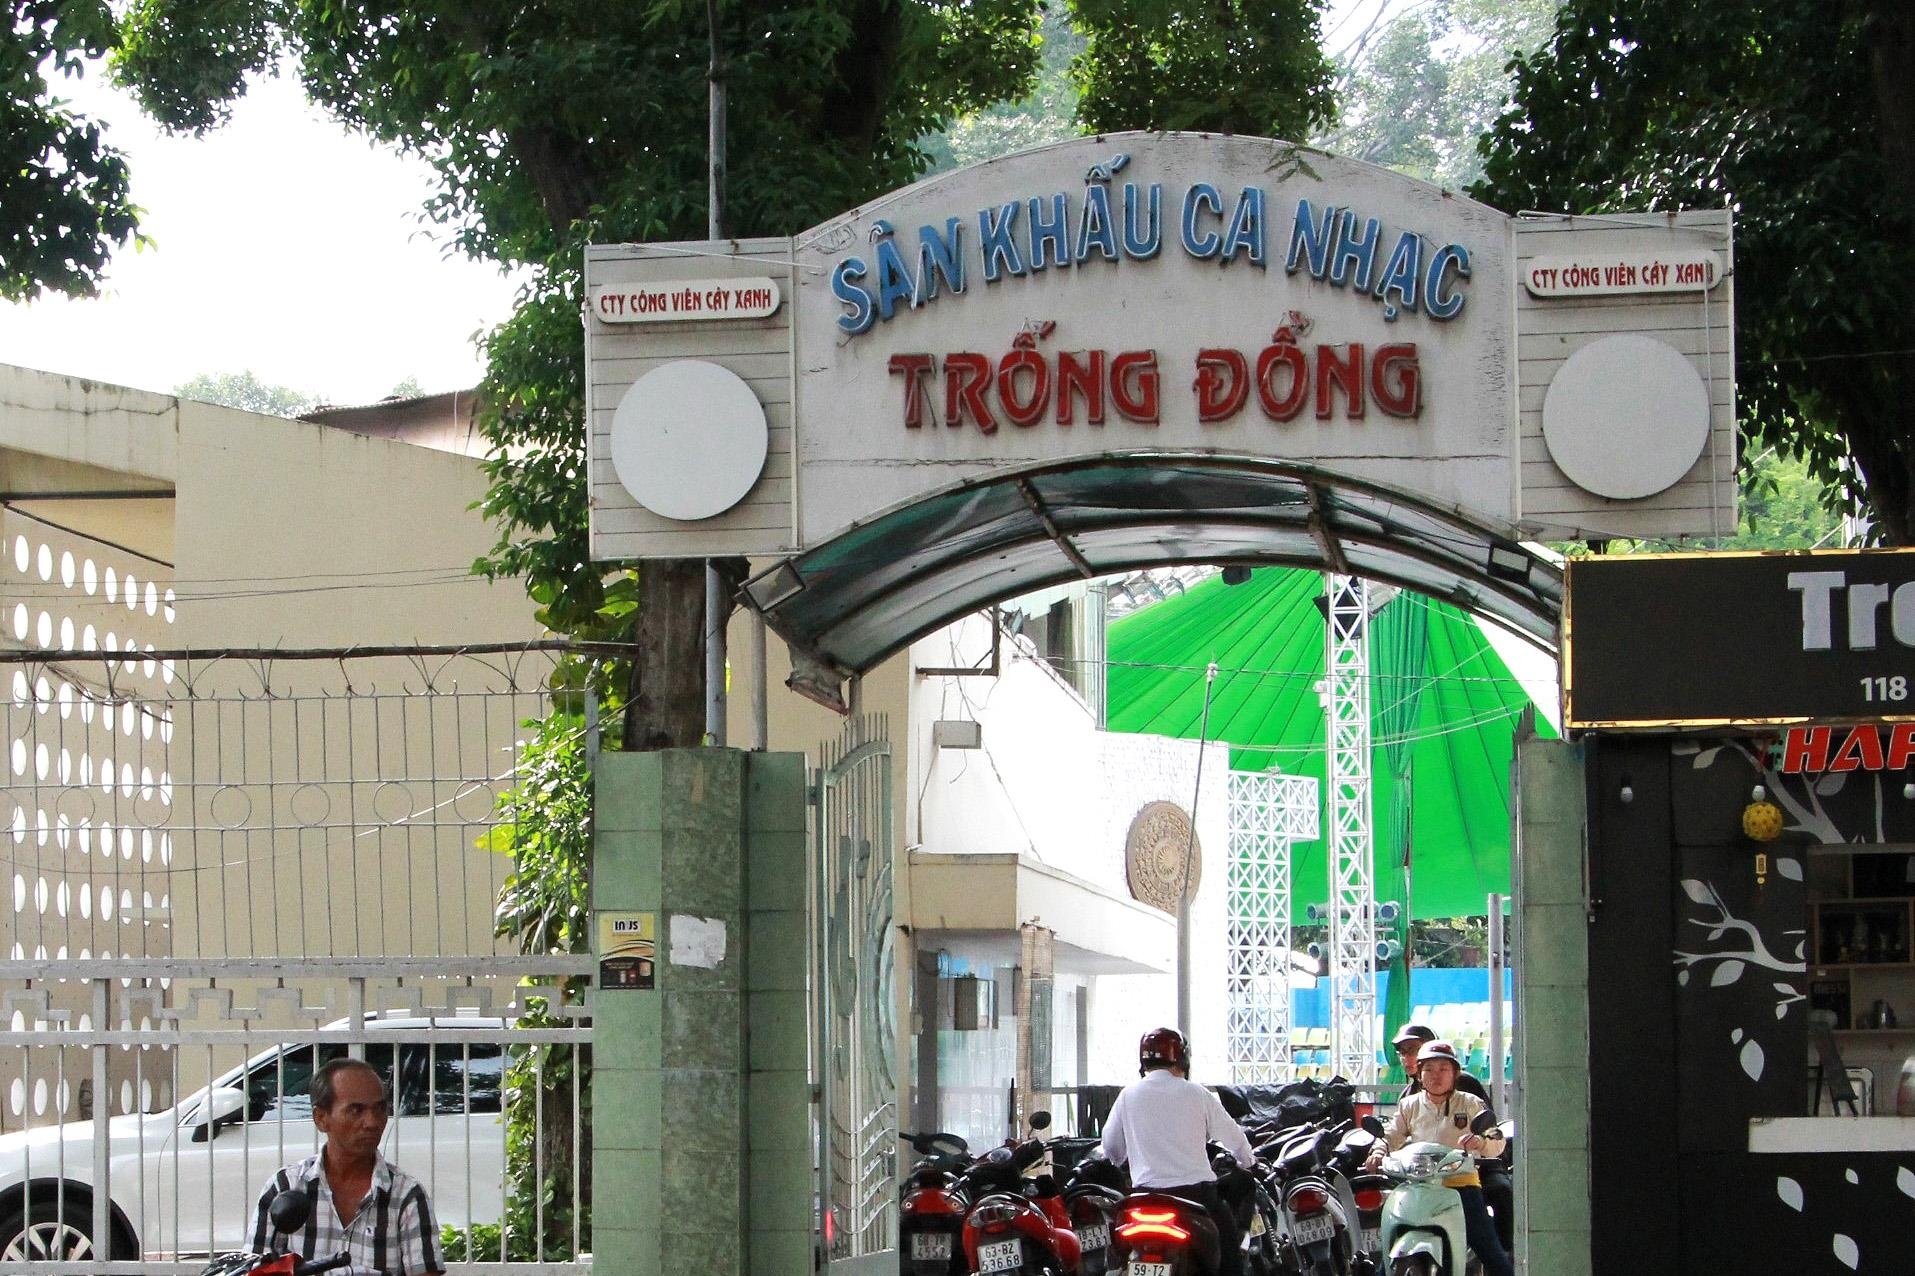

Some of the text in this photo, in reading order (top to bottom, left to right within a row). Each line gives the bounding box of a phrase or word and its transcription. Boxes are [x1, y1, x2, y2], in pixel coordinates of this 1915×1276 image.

[831, 153, 1473, 336] SÂN KHẤU CA NHẠC
[1532, 268, 1558, 289] CTY
[1562, 263, 1600, 288] CÔNG
[1604, 261, 1637, 287] VIÊN
[1641, 260, 1670, 286] CÂY
[600, 286, 771, 315] CTY CÔNG VIÊN CÂY XANH
[887, 316, 1161, 436] TRỐNG
[1860, 675, 1908, 702] 118
[985, 1242, 1015, 1259] 63-B2
